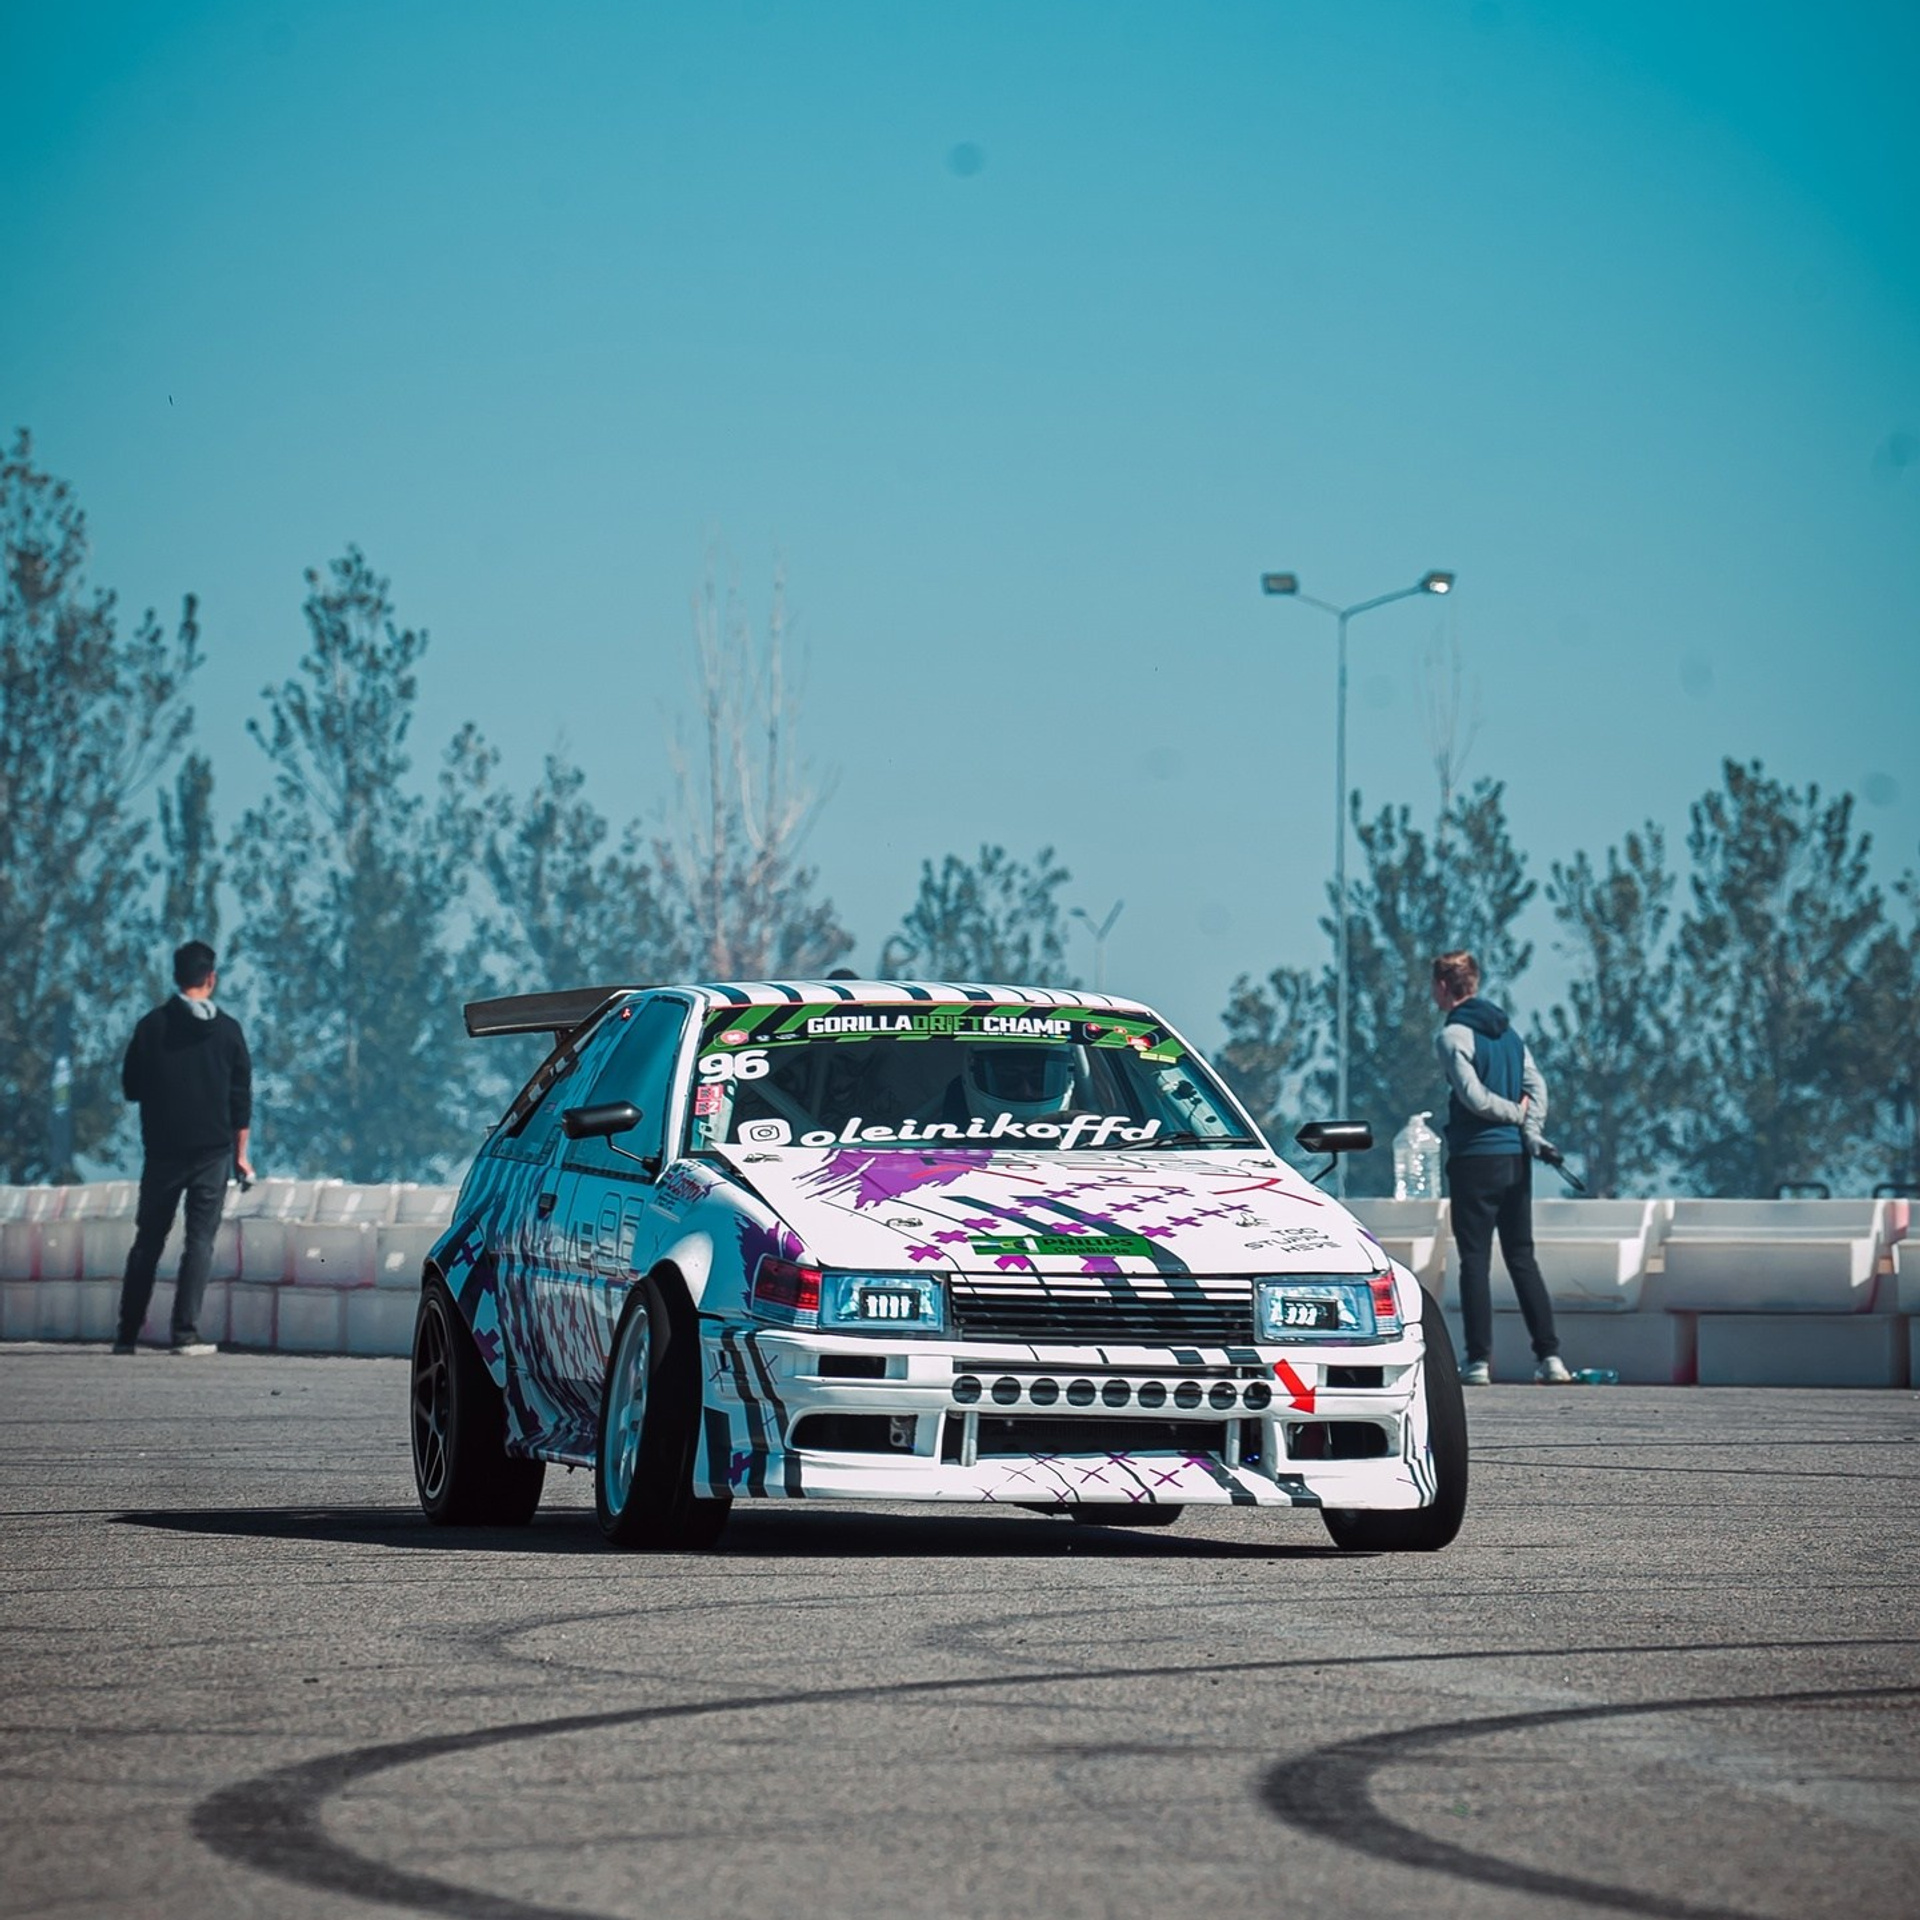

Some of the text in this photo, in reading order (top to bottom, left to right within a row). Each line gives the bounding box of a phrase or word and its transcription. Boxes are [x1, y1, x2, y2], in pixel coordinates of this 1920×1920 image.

[698, 1049, 770, 1084] 96
[799, 1112, 1162, 1151] oleinikoffd
[1041, 1237, 1134, 1247] PHILIPS
